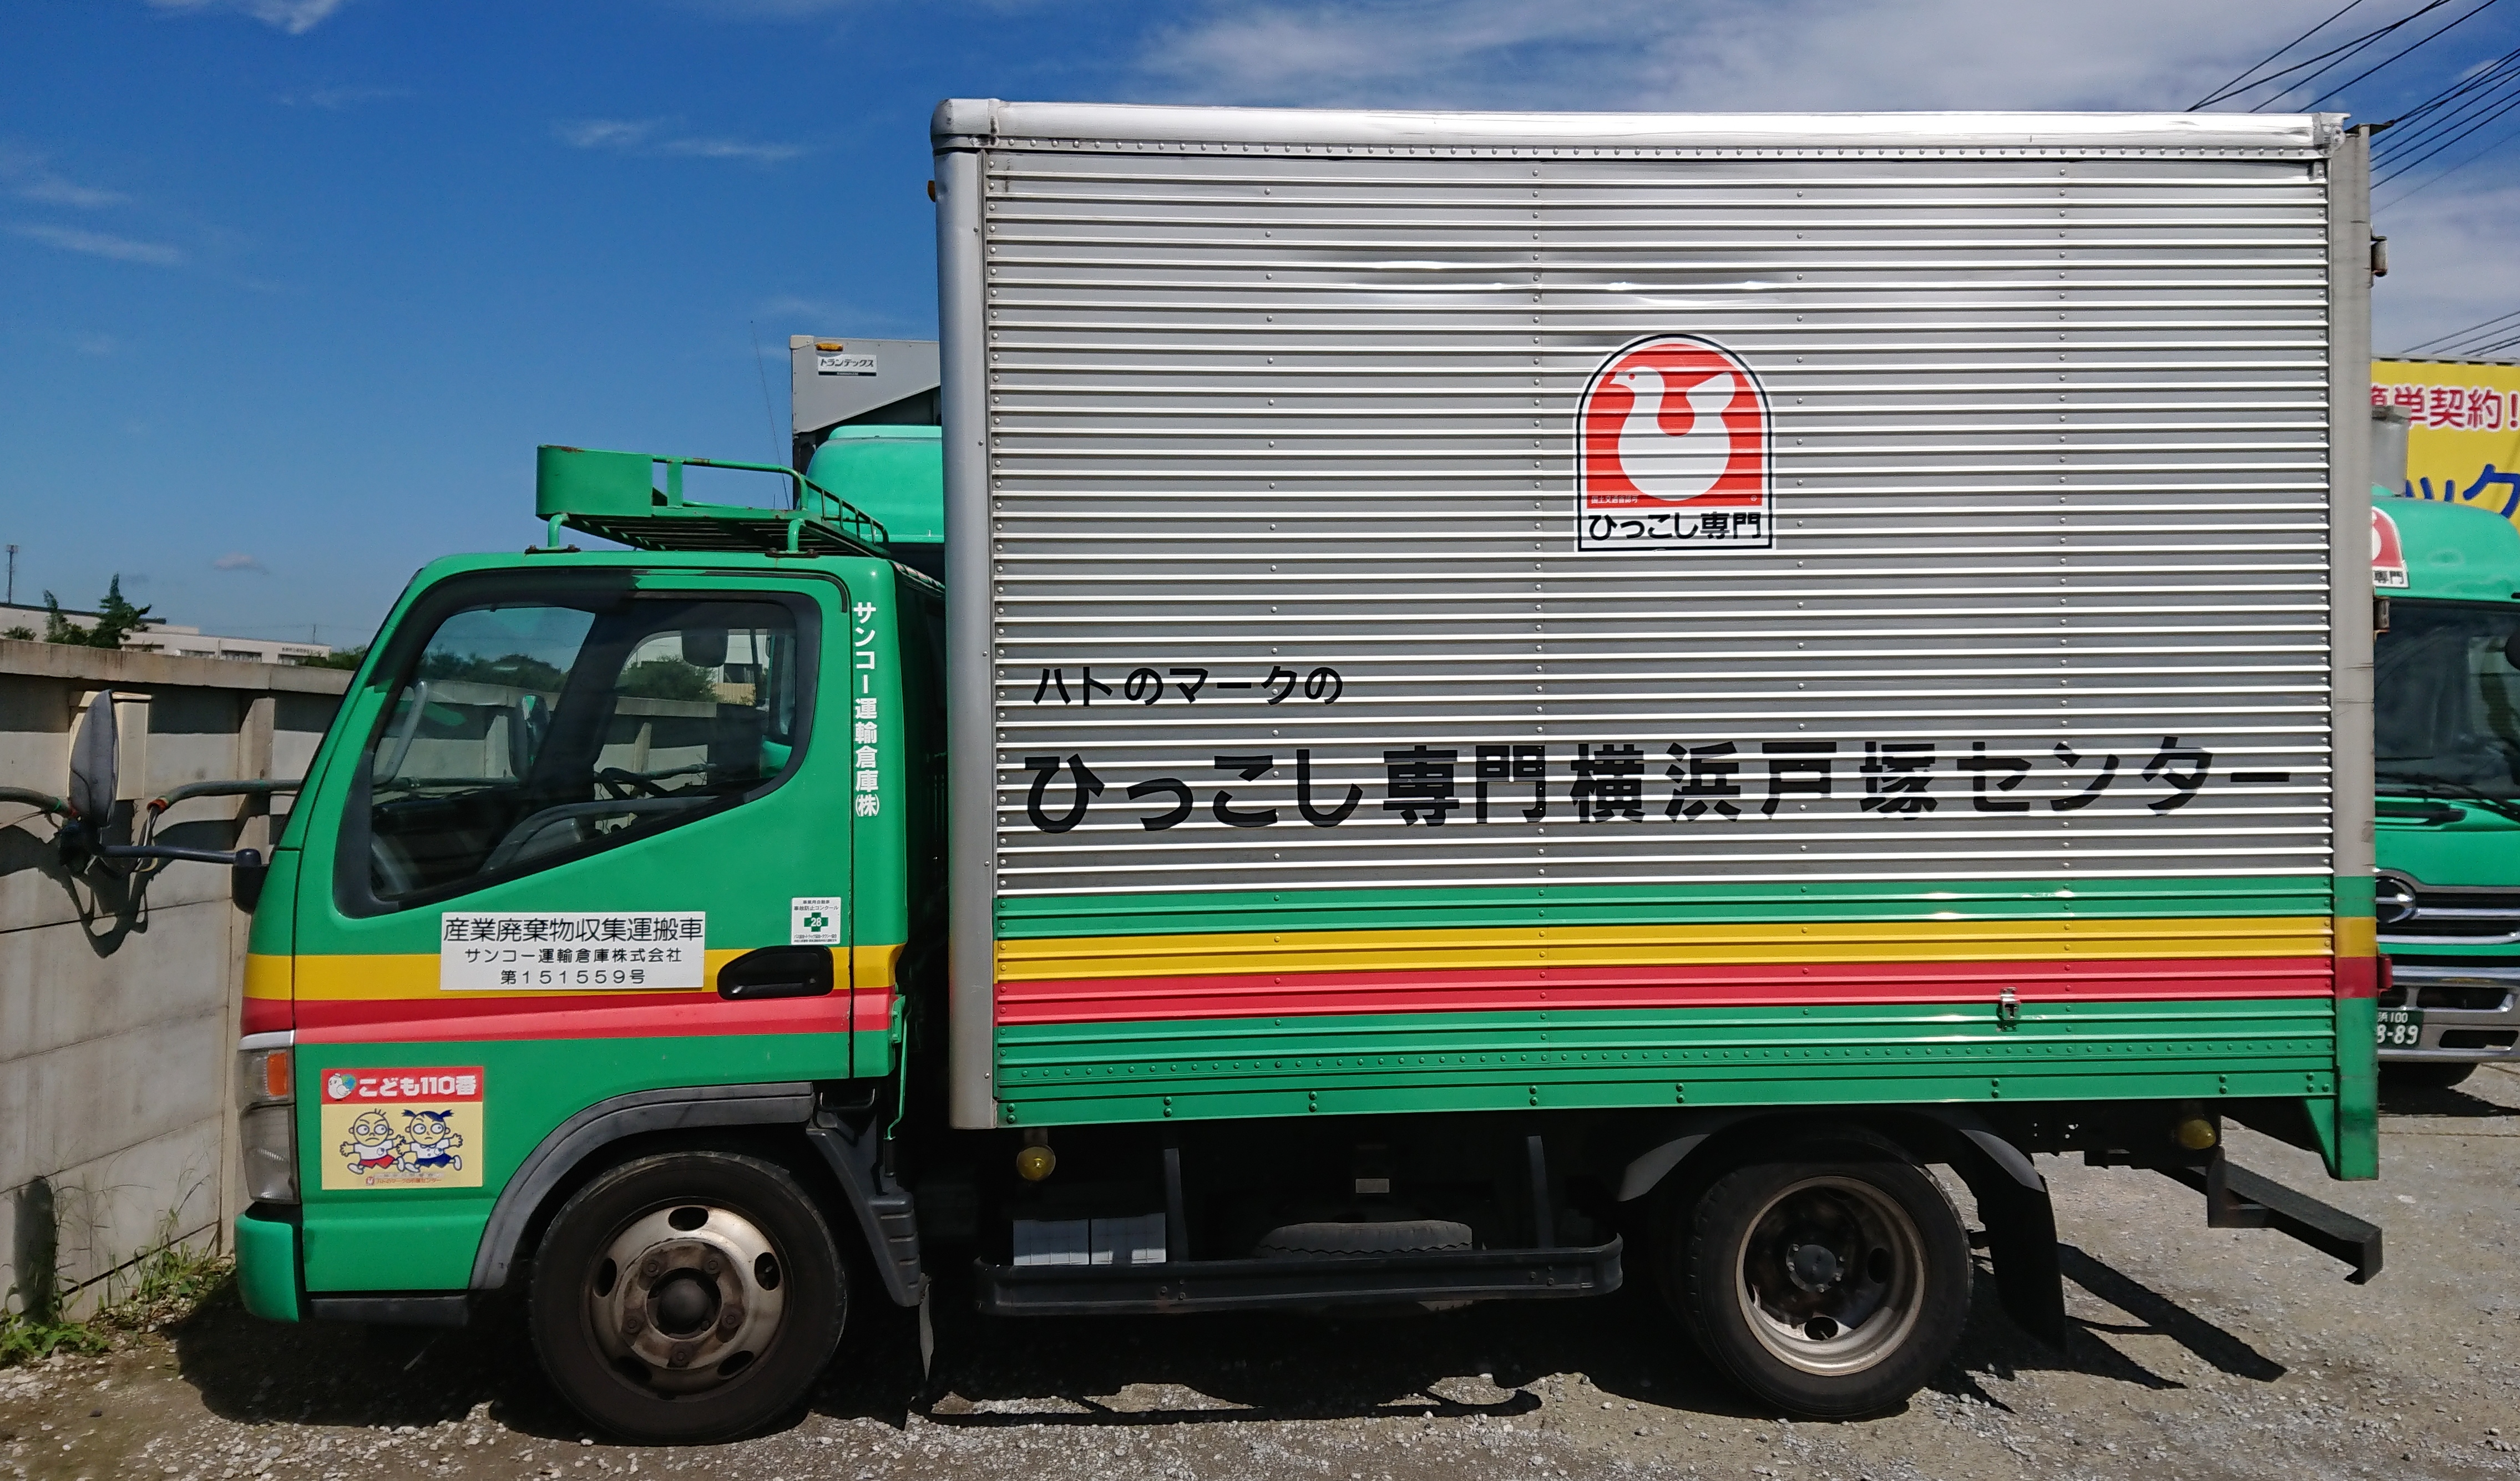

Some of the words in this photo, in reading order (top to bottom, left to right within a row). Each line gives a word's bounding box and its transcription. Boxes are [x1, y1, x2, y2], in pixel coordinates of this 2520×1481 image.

[820, 358, 874, 367] トランデックス
[1588, 511, 1762, 541] ひっこし専門
[1033, 665, 1343, 707] ハトのマークの
[1024, 736, 2290, 834] ひっこし専門横浜戸塚センター
[444, 917, 704, 942] 産業廃棄物収集運搬車
[811, 917, 822, 927] 28
[464, 947, 682, 963] サンコー運輸倉庫株式会社
[500, 969, 646, 985] 第151559号
[358, 1075, 477, 1097] こども110番
